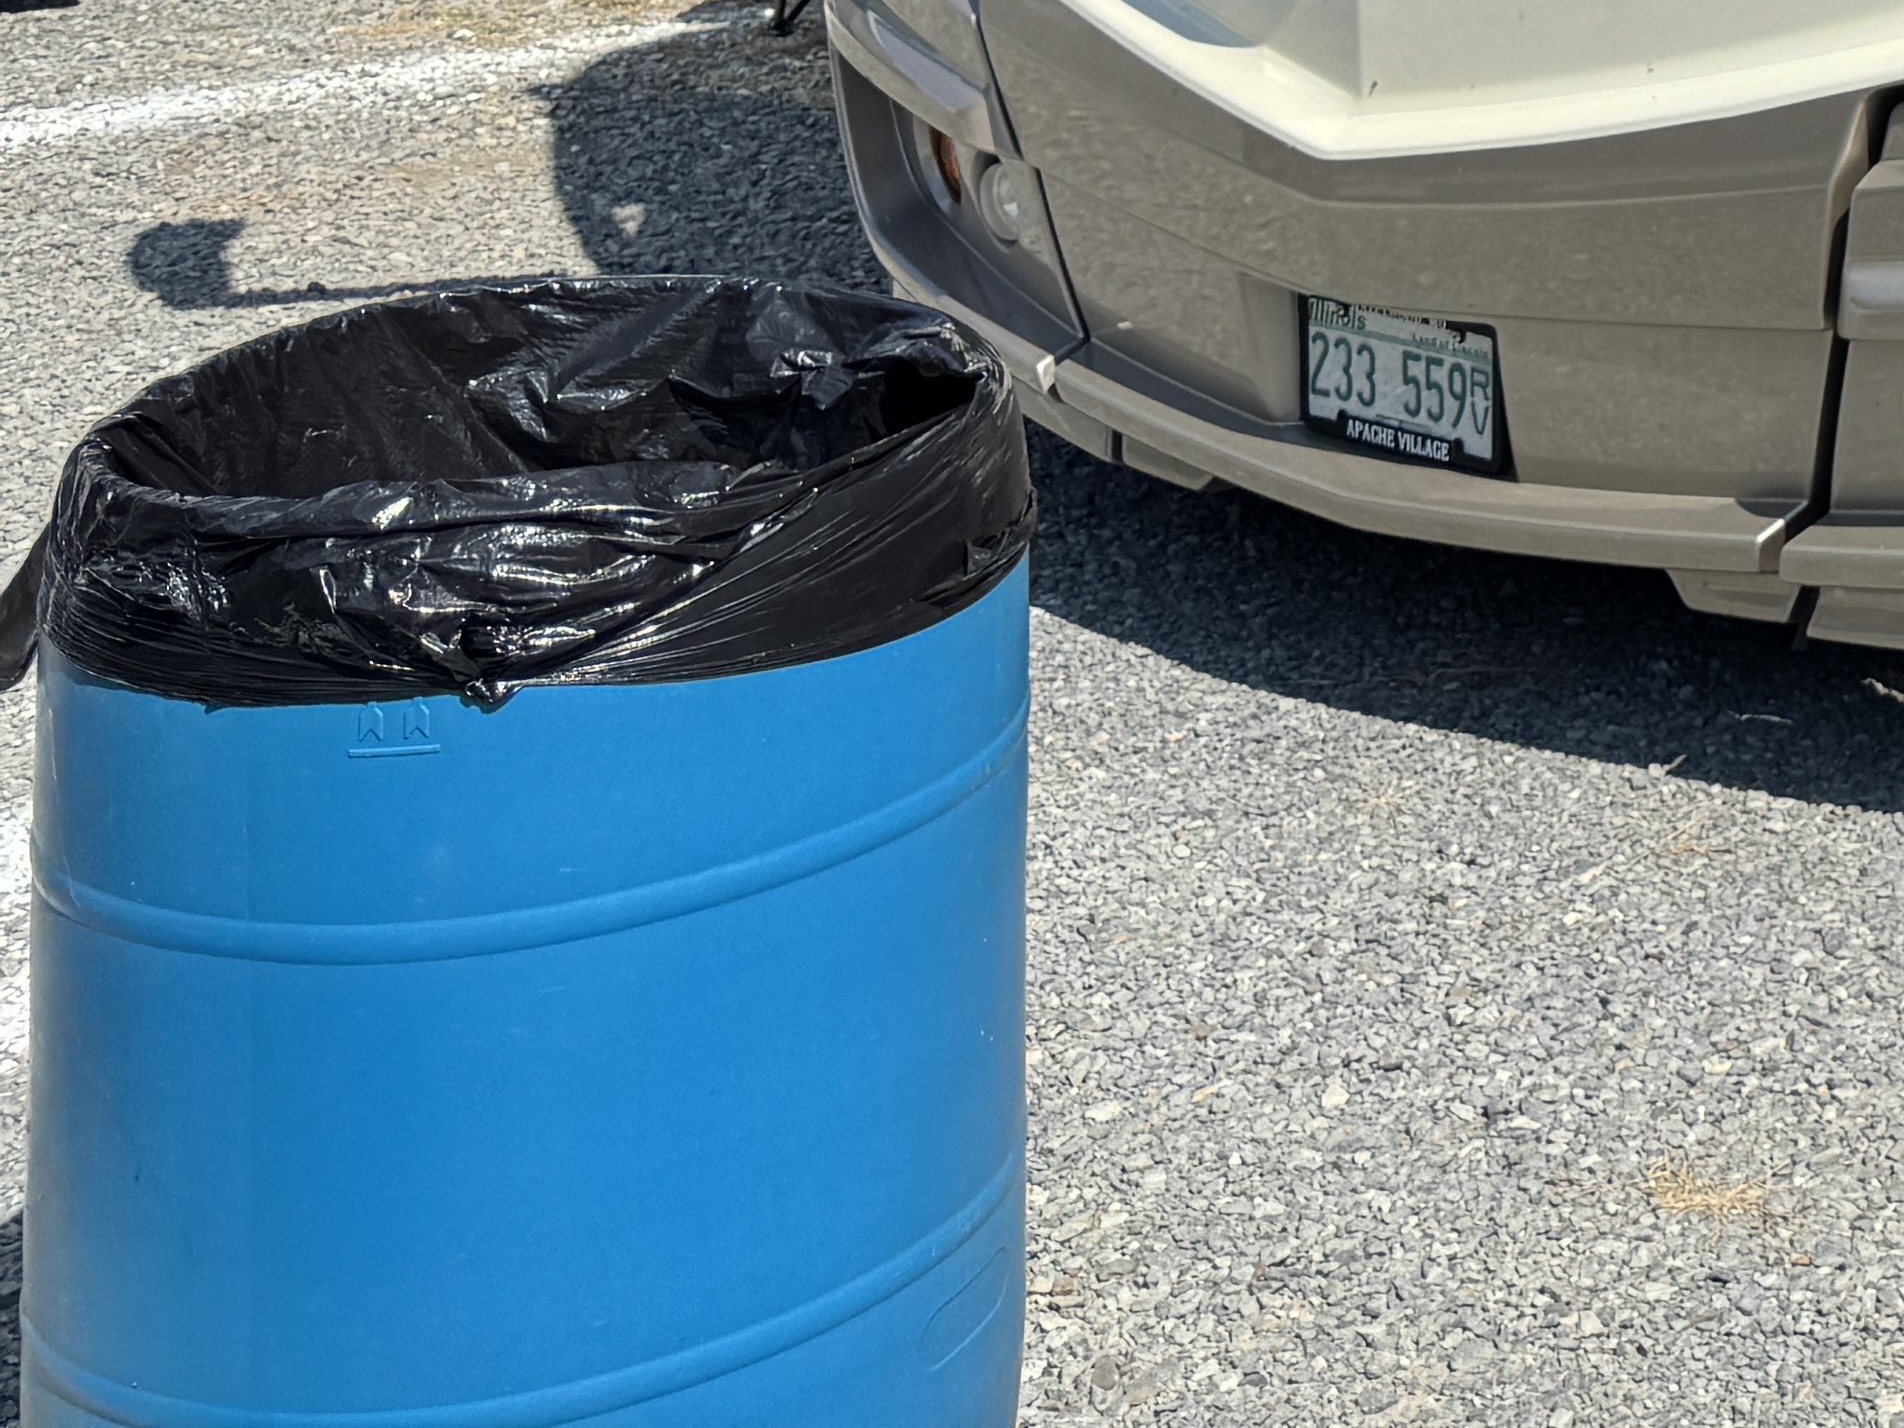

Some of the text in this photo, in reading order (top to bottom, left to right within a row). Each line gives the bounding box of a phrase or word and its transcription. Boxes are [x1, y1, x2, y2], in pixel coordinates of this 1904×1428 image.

[1311, 331, 1376, 407] 233
[1402, 350, 1467, 429] 559
[1346, 419, 1449, 461] APACHE VILLAGE
